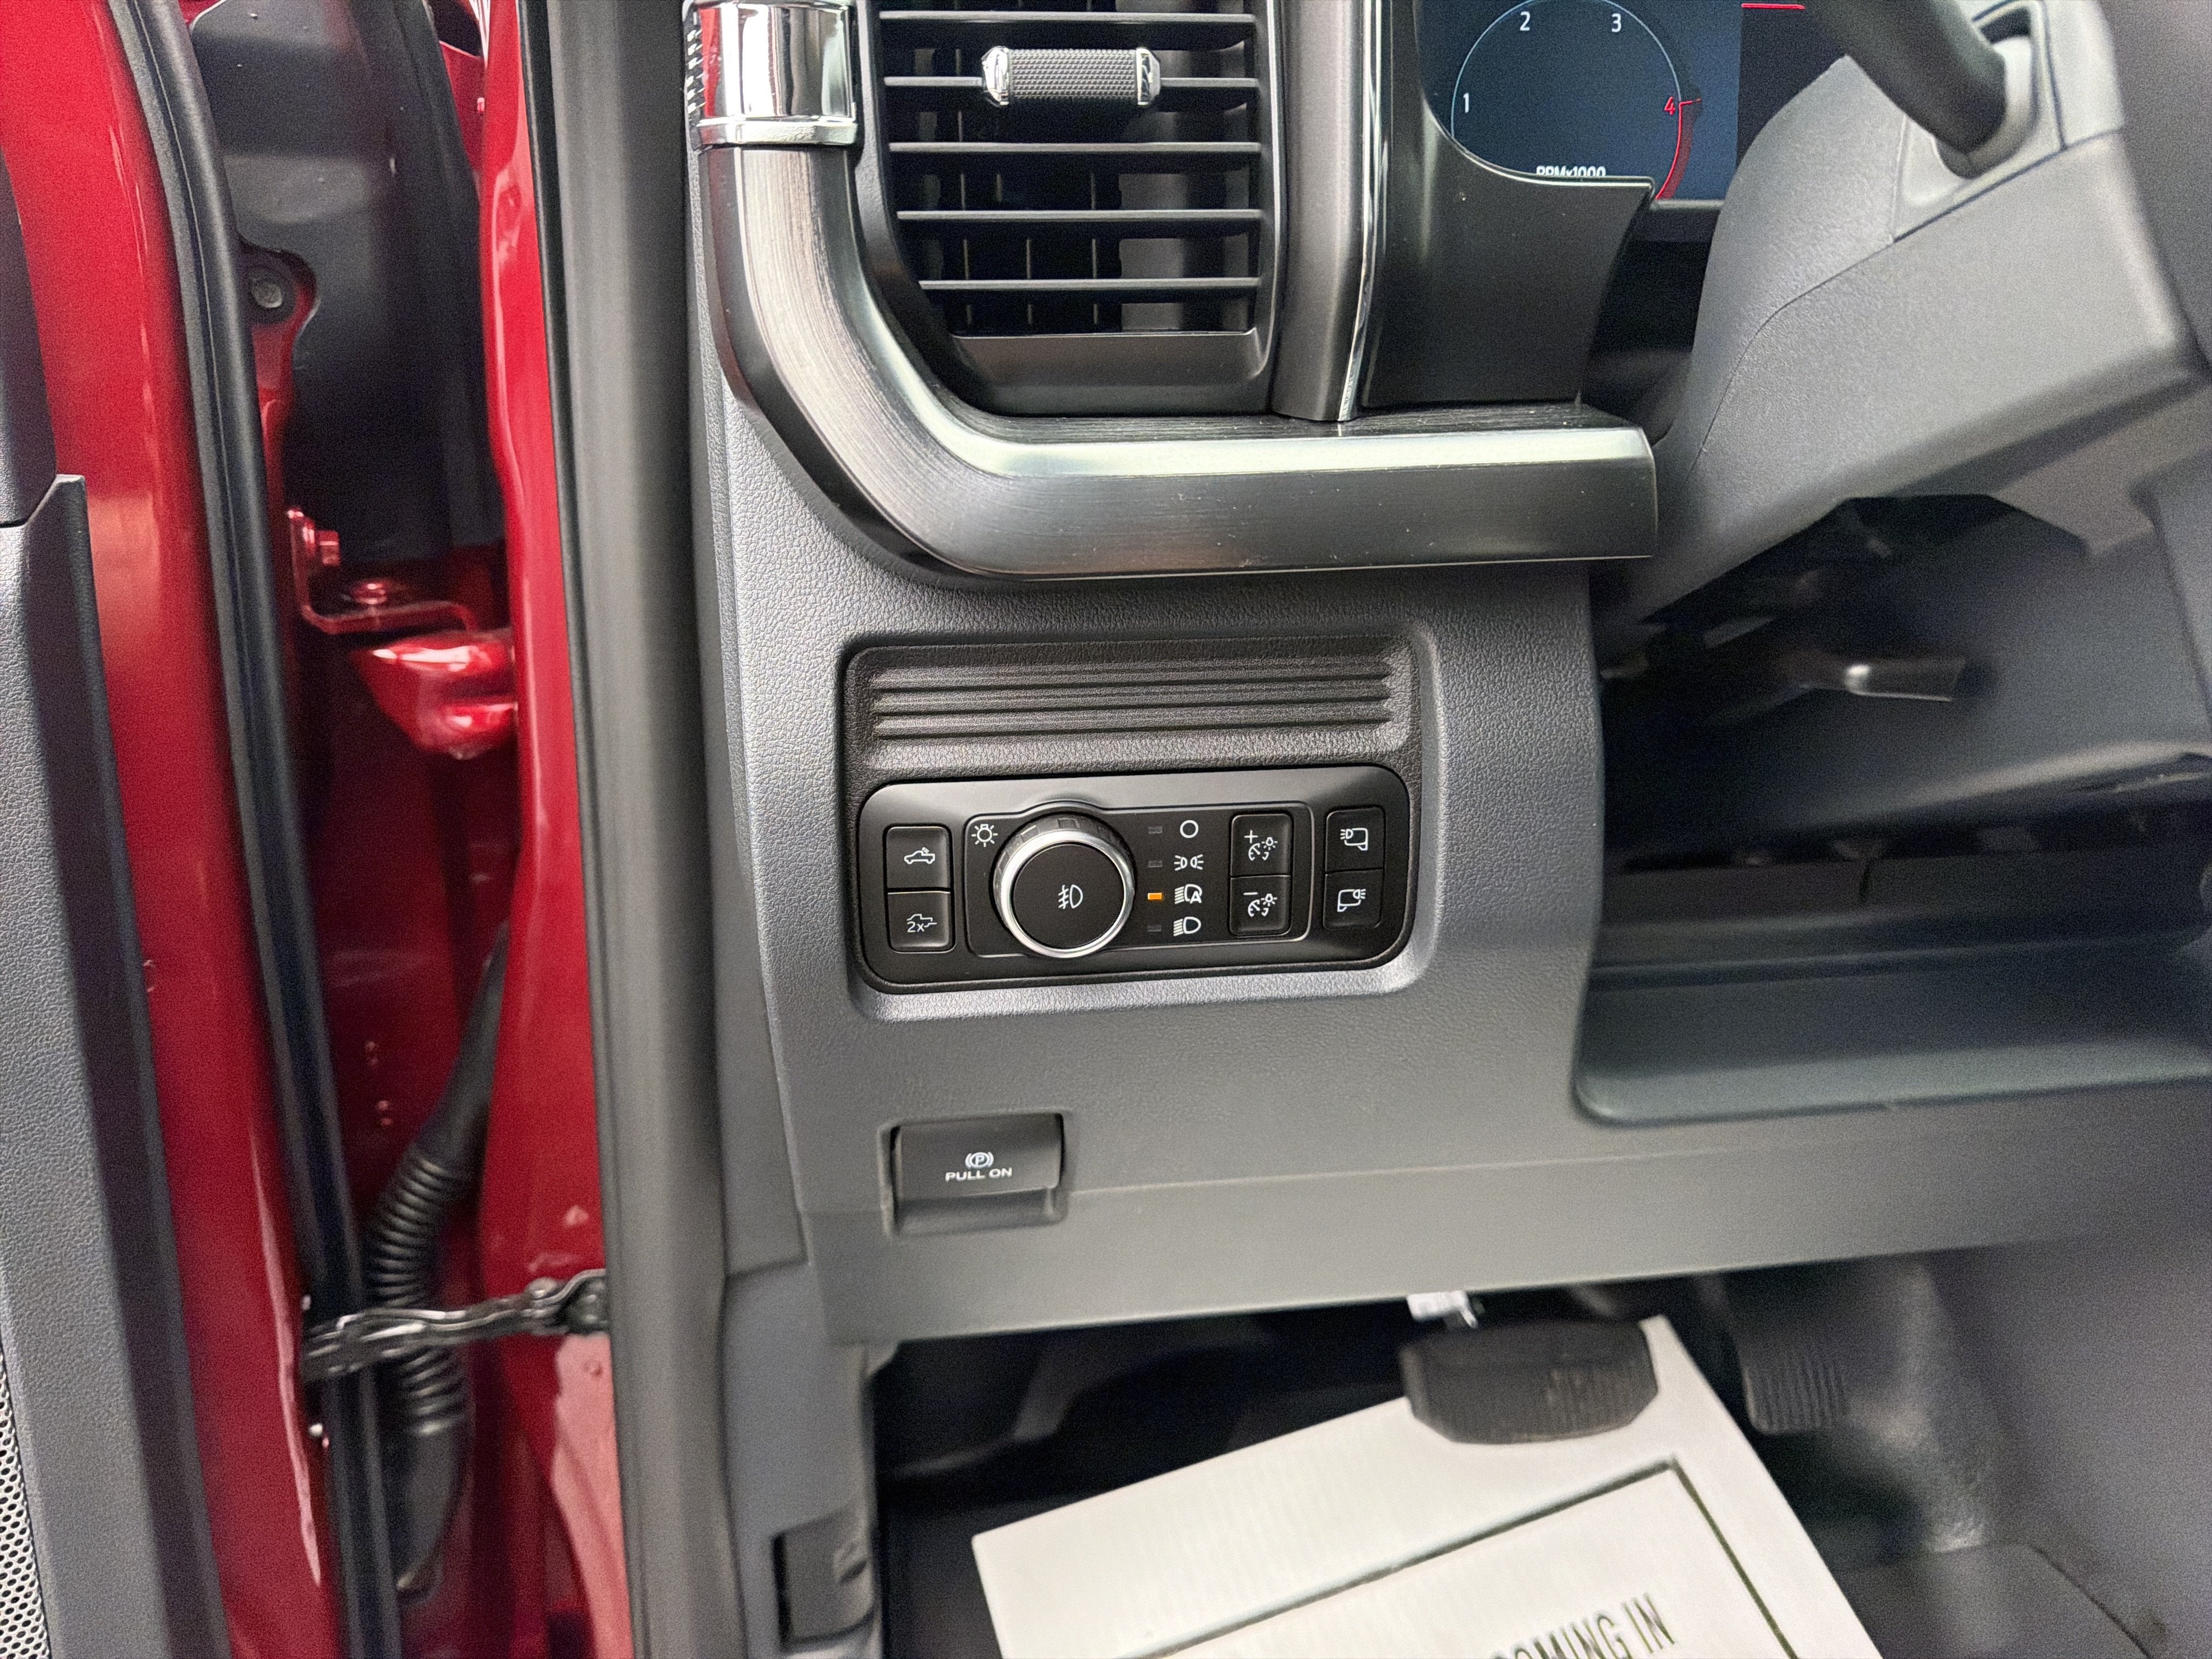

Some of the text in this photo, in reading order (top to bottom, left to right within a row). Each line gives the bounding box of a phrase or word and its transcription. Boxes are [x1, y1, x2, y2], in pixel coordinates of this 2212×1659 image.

[1519, 12, 1531, 31] 2
[1611, 13, 1622, 33] 3
[1462, 92, 1470, 113] 1
[1663, 96, 1676, 115] 4
[906, 921, 925, 933] 2x
[945, 1167, 1013, 1182] PULL ON
[1490, 1593, 1675, 1659] MING IN
